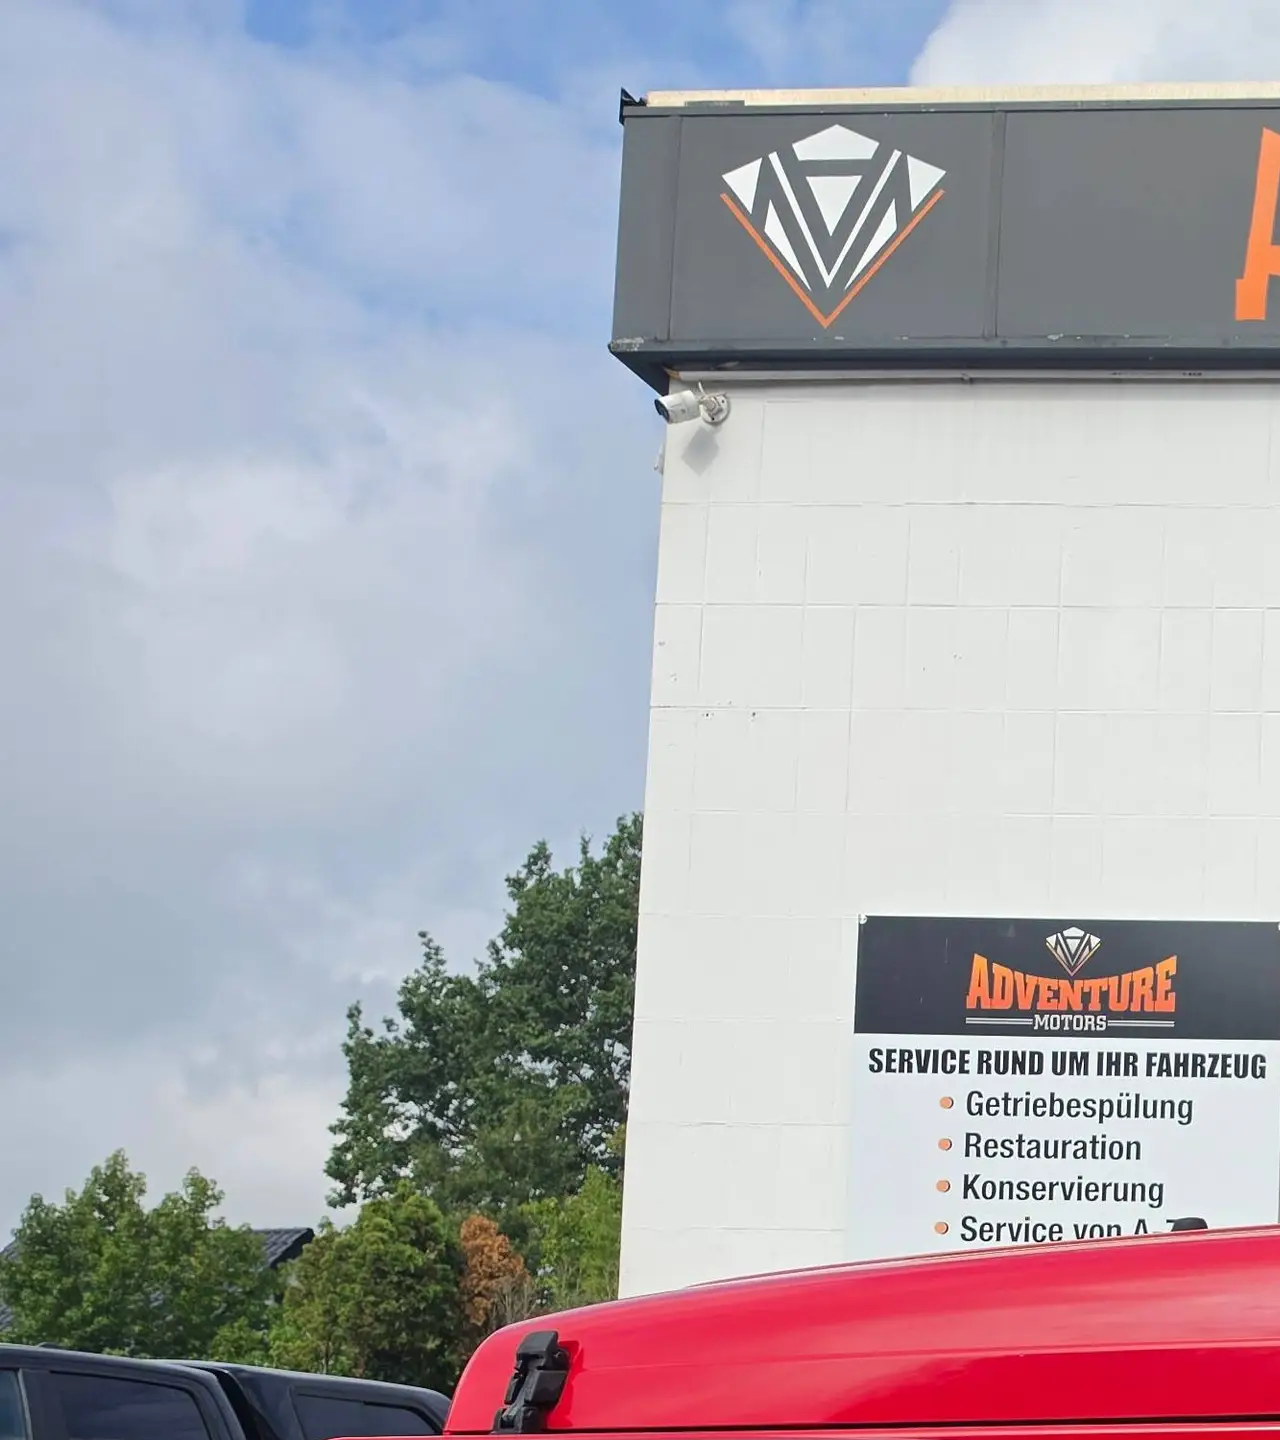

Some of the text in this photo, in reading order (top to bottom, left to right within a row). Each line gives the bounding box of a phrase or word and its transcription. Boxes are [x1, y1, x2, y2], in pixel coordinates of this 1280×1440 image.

[965, 953, 1178, 1013] ADVENTURE
[1033, 1014, 1107, 1032] MOTORS
[868, 1048, 1266, 1079] SERVICE RUND UM IHR FAHRZEUG
[966, 1090, 1193, 1125] Getriebespülung
[964, 1132, 1141, 1160] Restauration
[962, 1174, 1164, 1208] Konservierung
[960, 1216, 1063, 1242] Service
[1074, 1222, 1121, 1240] von
